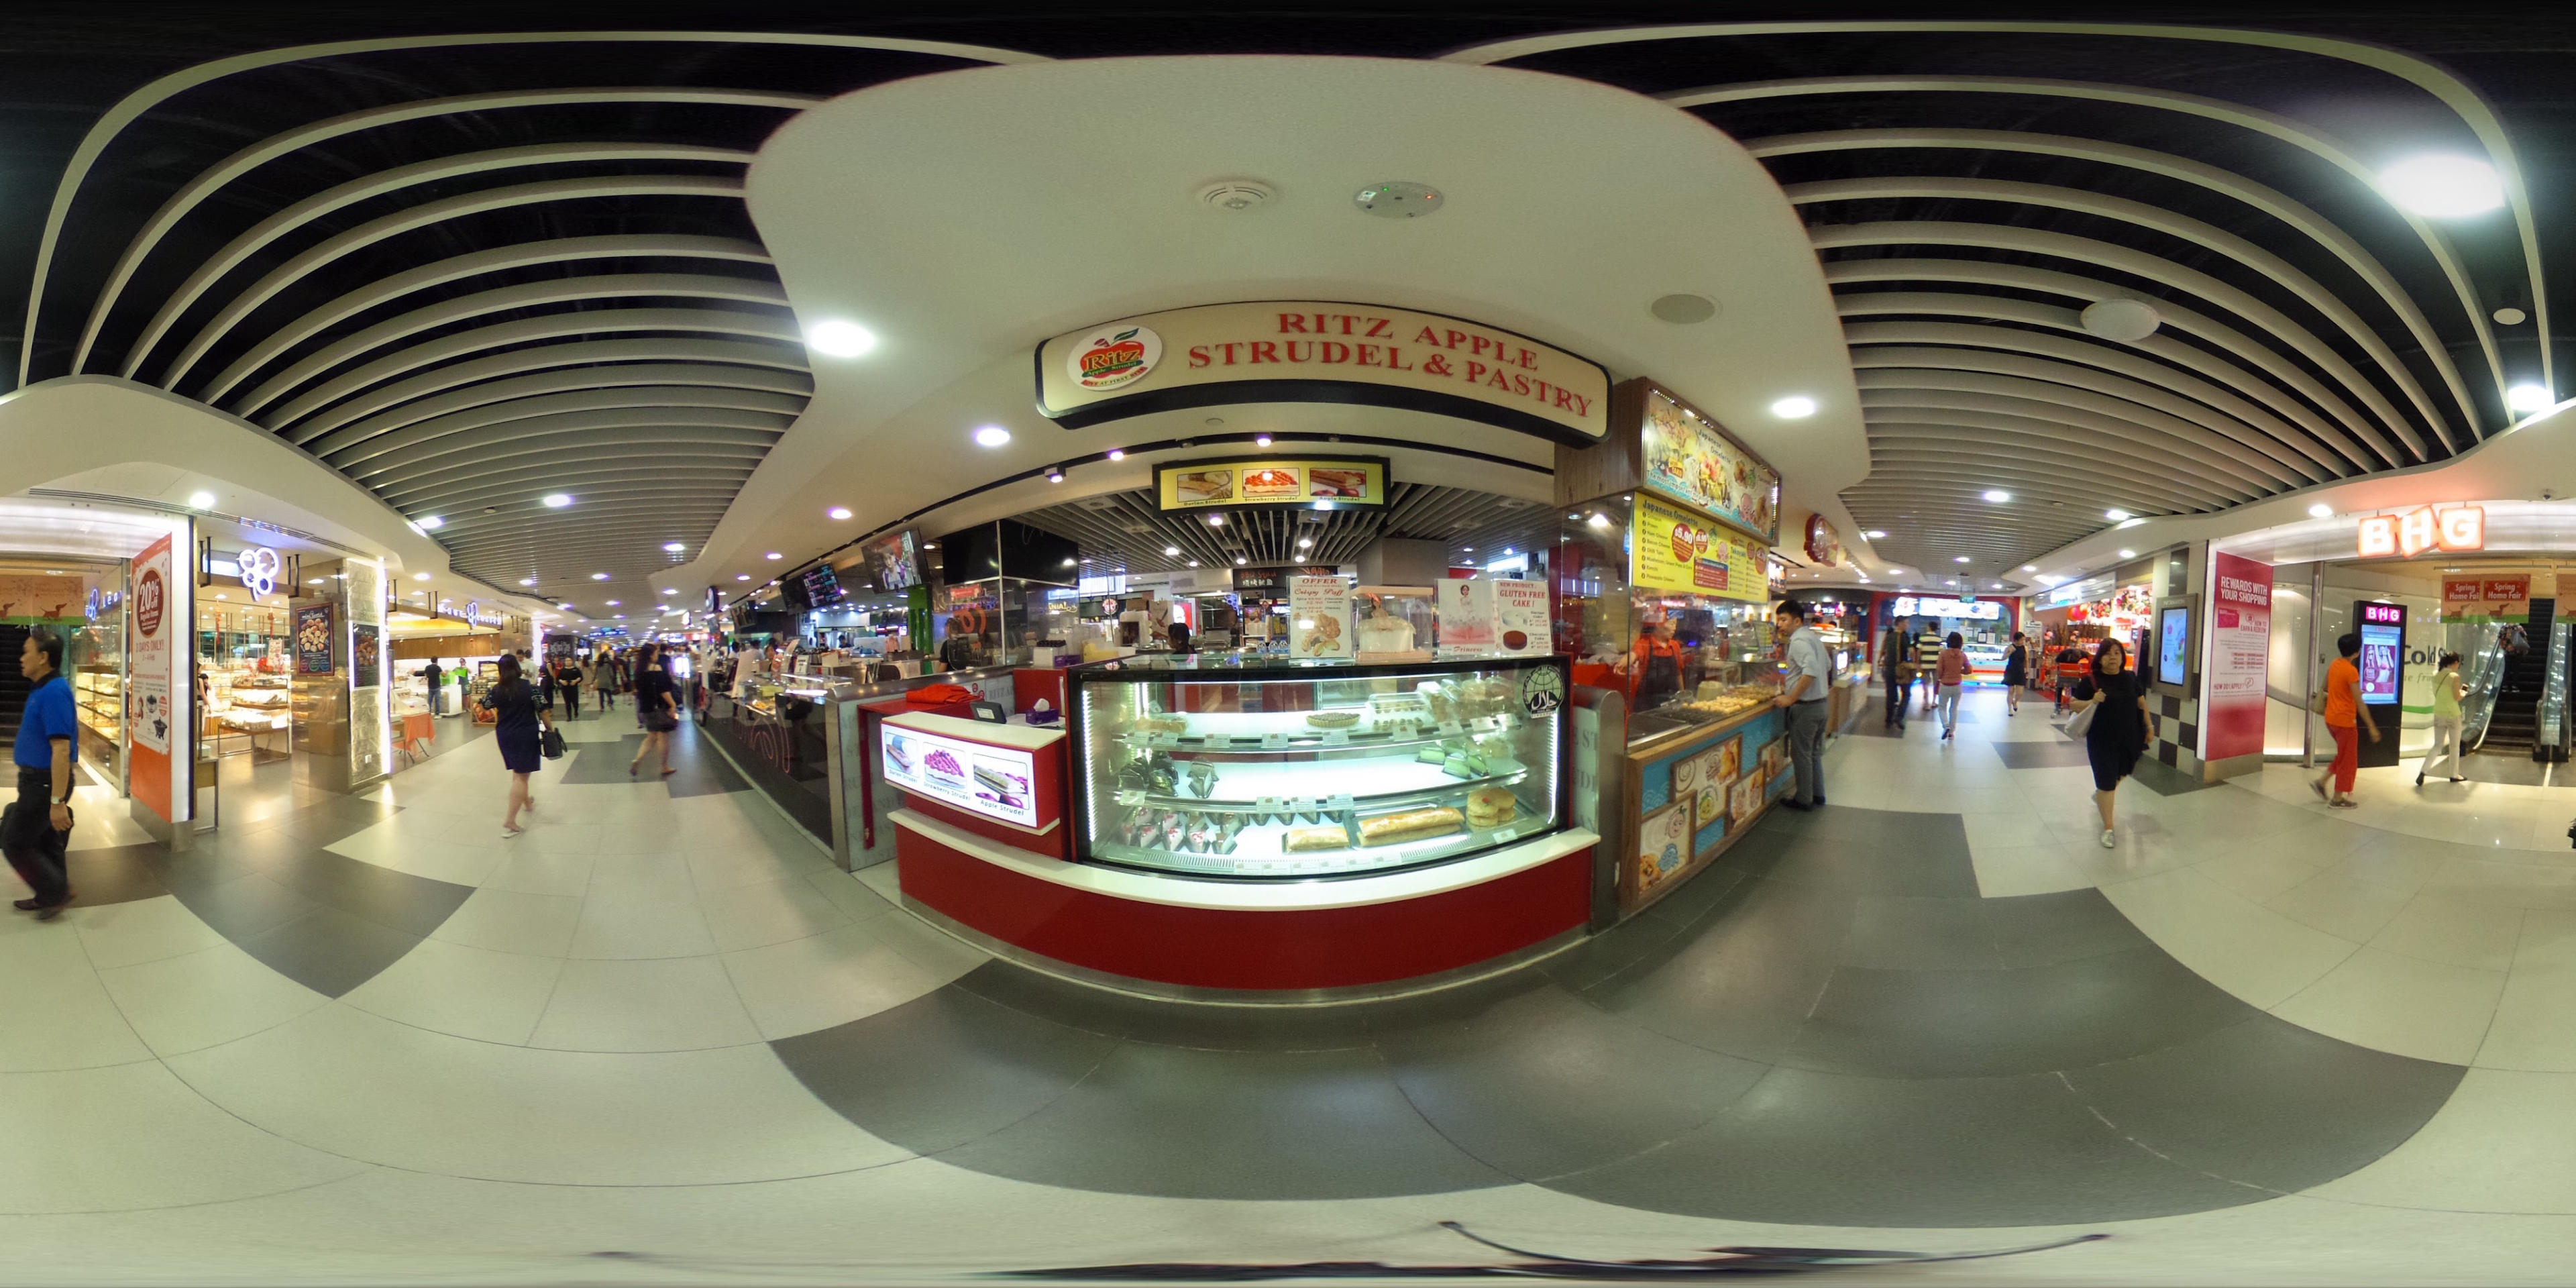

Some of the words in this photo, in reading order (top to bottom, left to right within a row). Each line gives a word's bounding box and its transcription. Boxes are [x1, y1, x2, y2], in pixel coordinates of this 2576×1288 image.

[1278, 313, 1394, 339] RITZ
[1413, 325, 1538, 371] APPLE
[1084, 350, 1140, 372] Ritz
[1087, 368, 1106, 376] Apple
[1189, 340, 1413, 371] STRUDEL
[1423, 354, 1454, 377] &
[1465, 361, 1593, 417] PASTRY
[1643, 499, 1672, 517] Japanese
[1674, 511, 1698, 527] Omelette
[2359, 506, 2483, 557] BHG
[1294, 588, 1320, 596] Crispy
[2221, 576, 2252, 593] REWARDS
[2253, 582, 2267, 596] WITH
[2456, 583, 2475, 593] Spring
[2494, 582, 2515, 593] Spring
[1499, 590, 1527, 598] GLUTEN
[1529, 590, 1546, 599] FREE
[2221, 588, 2238, 601] YOUR
[2239, 591, 2267, 606] SHOPPING
[2449, 592, 2468, 600] Home
[2488, 591, 2507, 599] Home
[2508, 591, 2522, 599] Fair
[2367, 606, 2400, 622] BHG
[139, 641, 150, 653] DAYS
[924, 781, 949, 794] Strawberry
[951, 790, 971, 800] Strudel
[980, 800, 998, 808] Apple
[1000, 805, 1024, 816] Strudel
